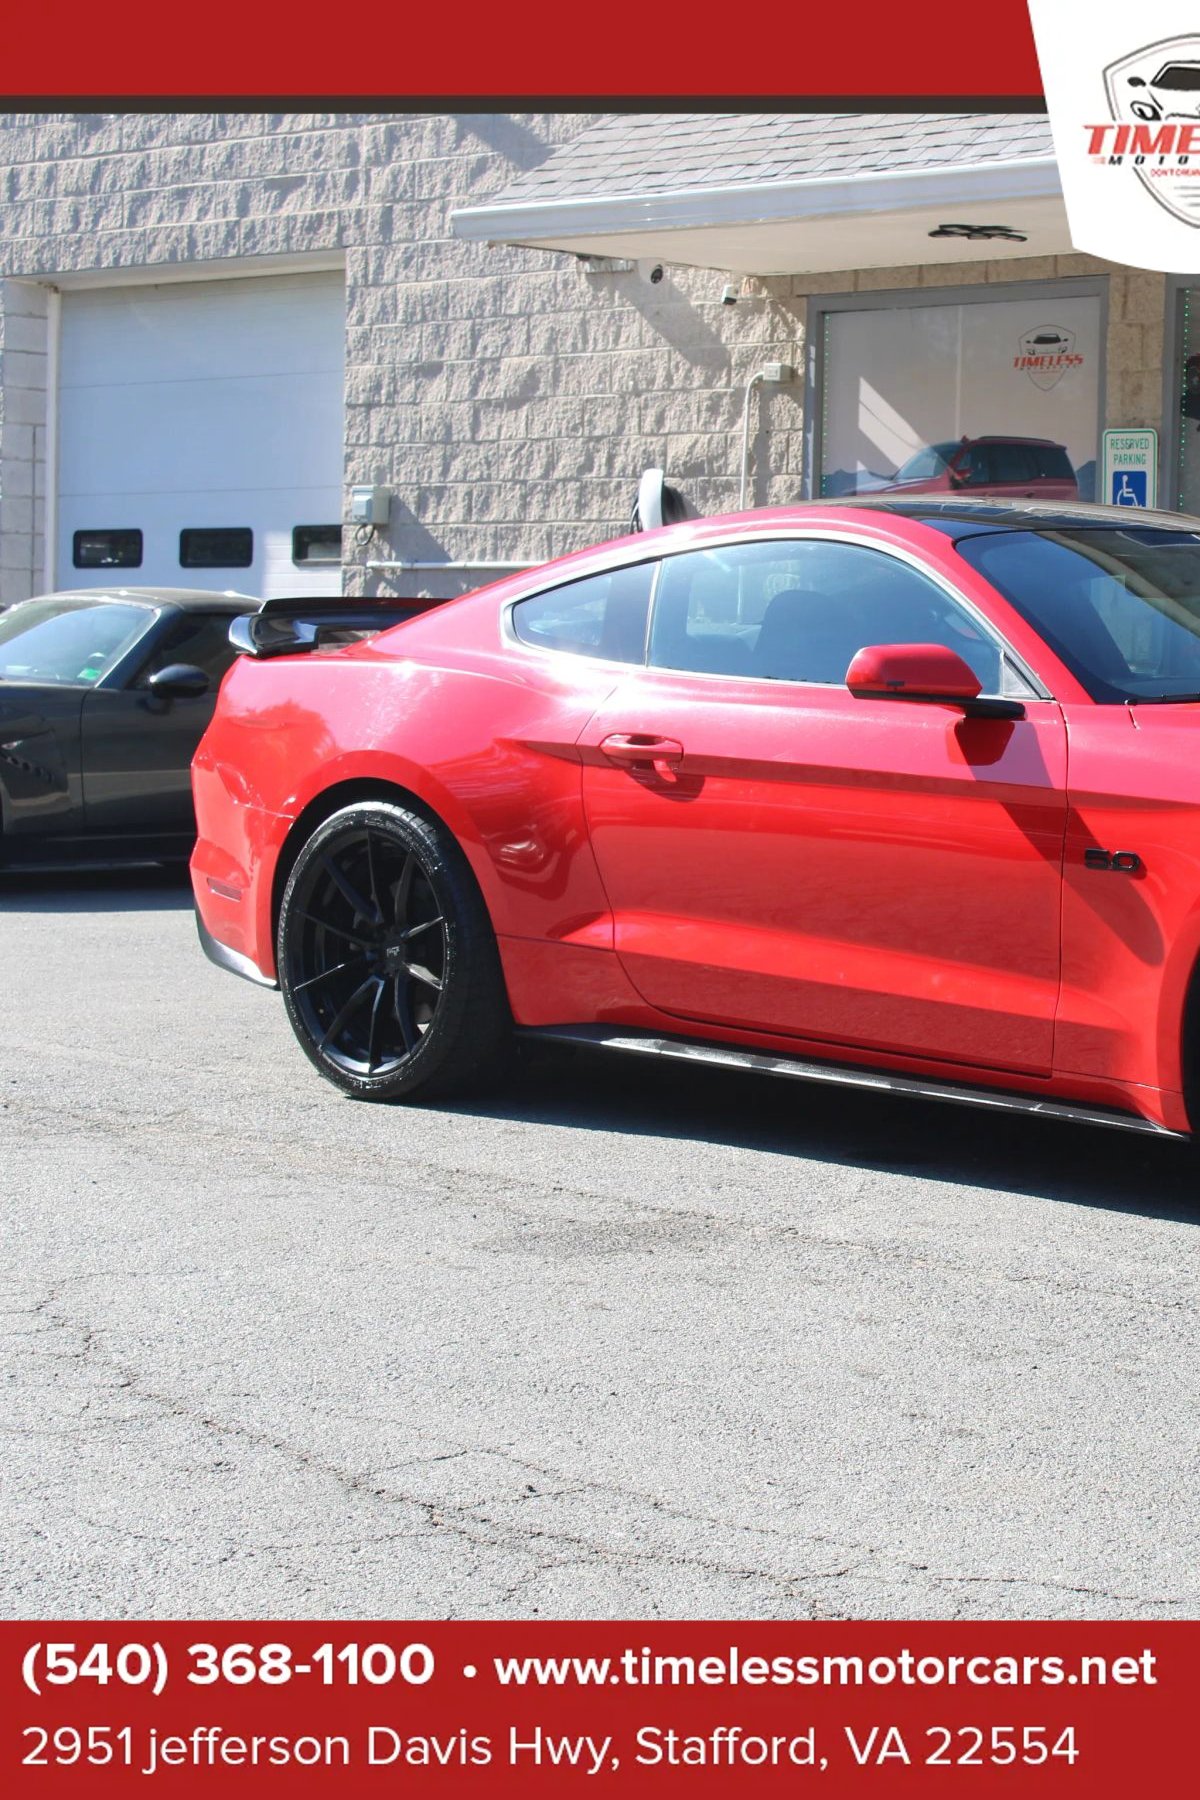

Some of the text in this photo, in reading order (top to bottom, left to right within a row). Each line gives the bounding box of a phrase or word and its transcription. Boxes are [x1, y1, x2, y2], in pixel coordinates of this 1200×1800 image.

[1013, 353, 1084, 369] TIMELESS
[1110, 438, 1149, 450] RESERVED
[1113, 453, 1147, 465] PARKING
[1084, 847, 1140, 873] 5.0
